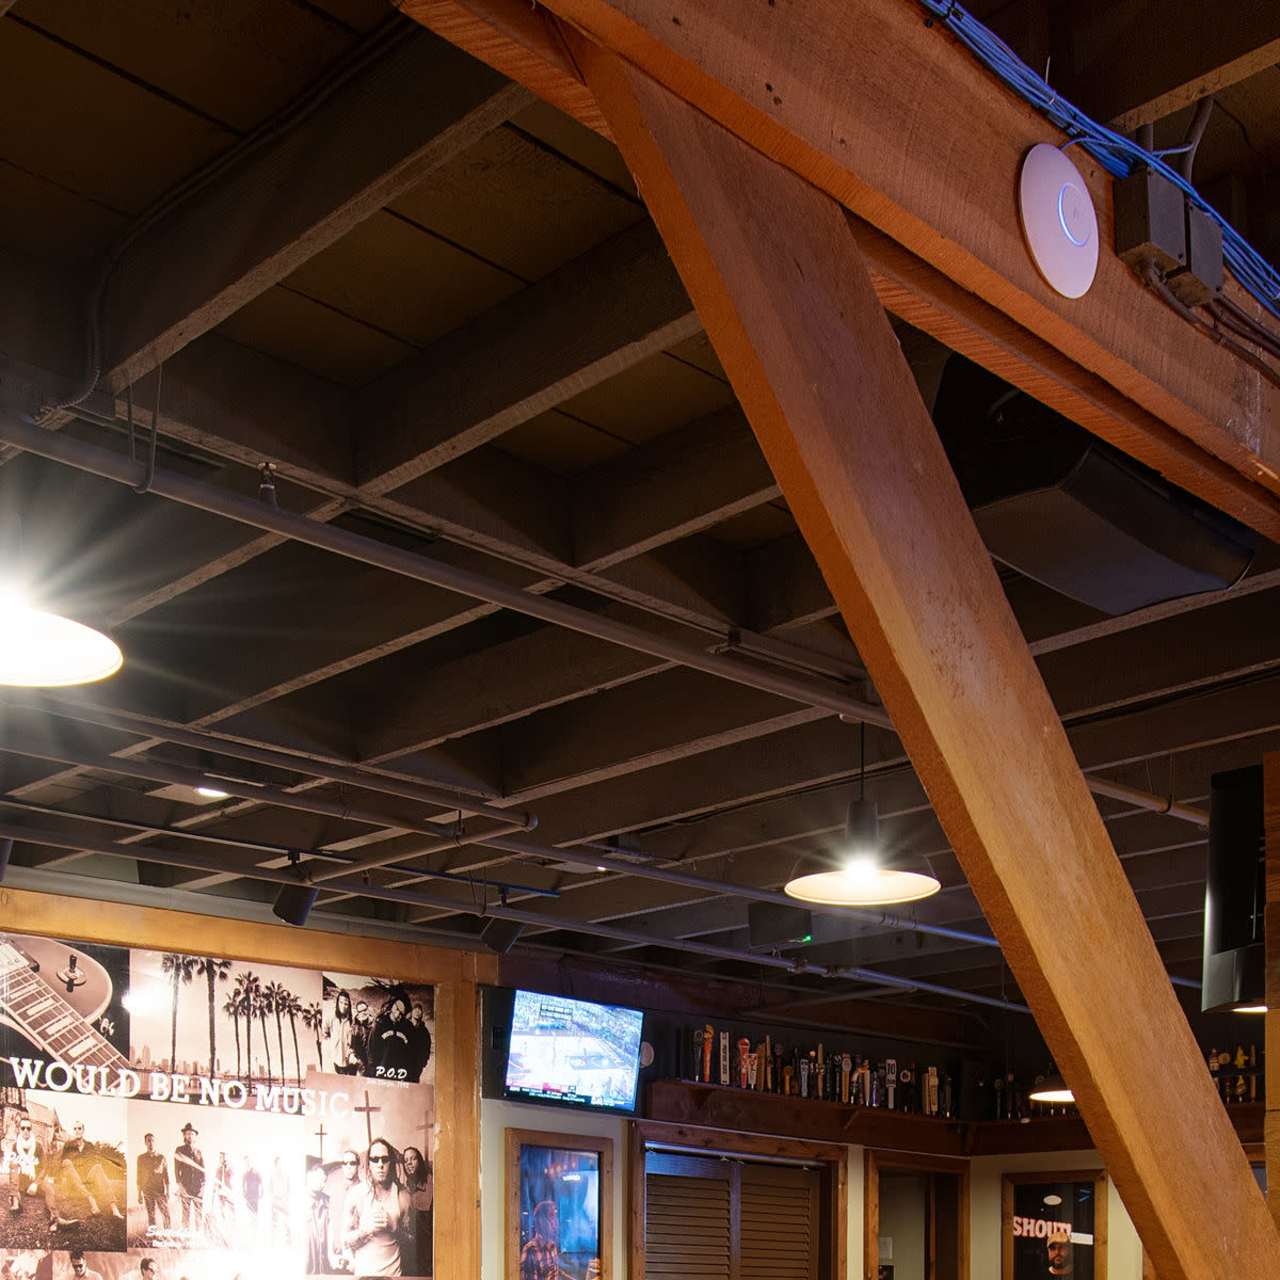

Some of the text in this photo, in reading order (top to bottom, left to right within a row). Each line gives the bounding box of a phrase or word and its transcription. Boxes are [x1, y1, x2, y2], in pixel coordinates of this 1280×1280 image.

[9, 1056, 142, 1098] WOULD
[150, 1072, 190, 1103] BE
[199, 1079, 248, 1109] NO
